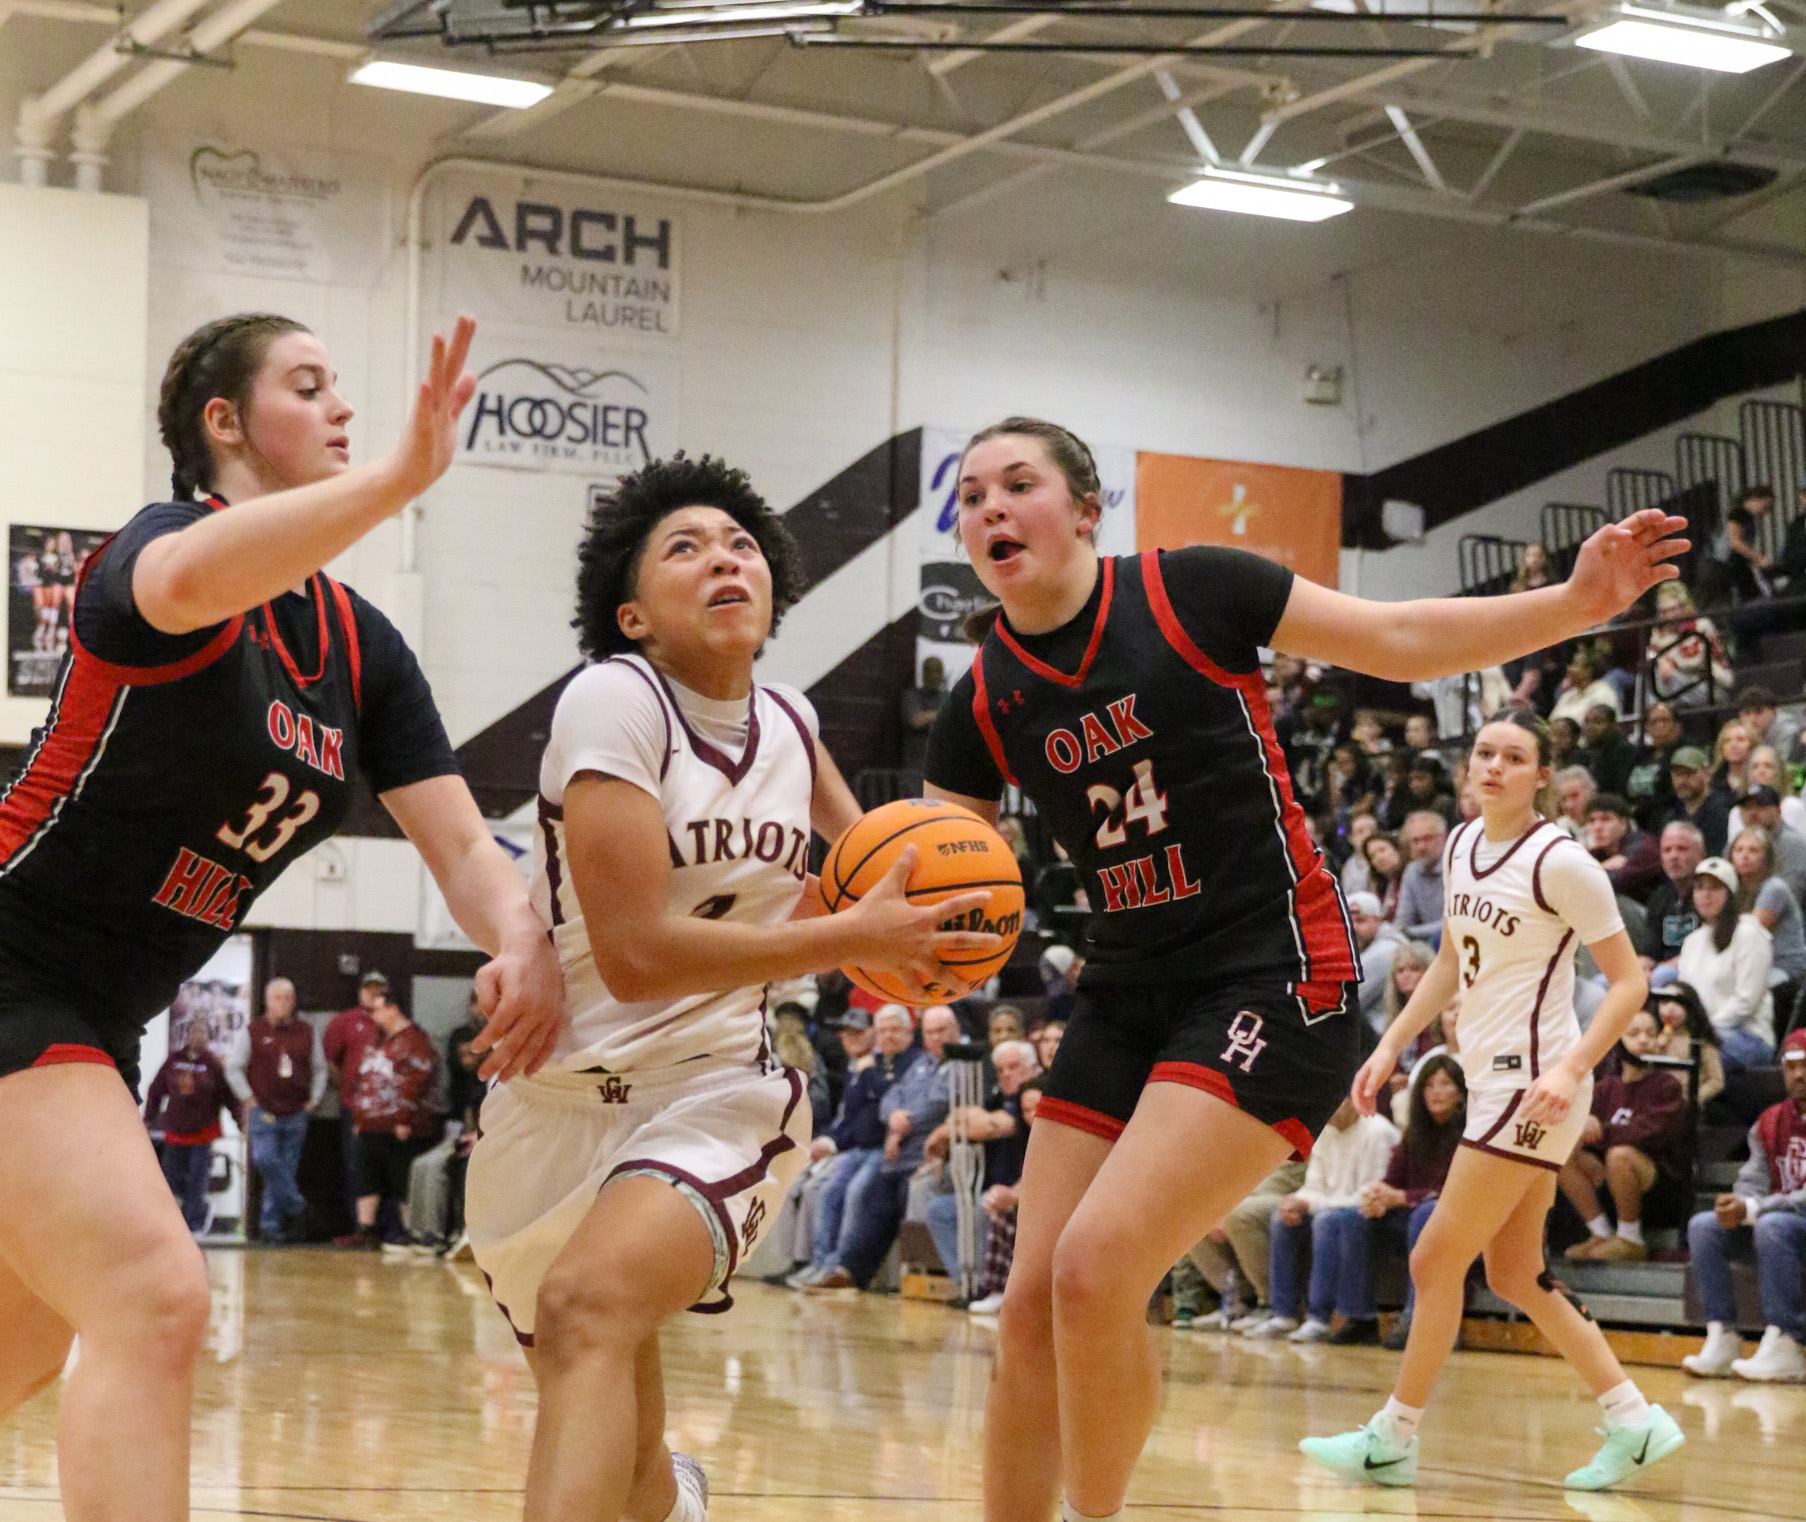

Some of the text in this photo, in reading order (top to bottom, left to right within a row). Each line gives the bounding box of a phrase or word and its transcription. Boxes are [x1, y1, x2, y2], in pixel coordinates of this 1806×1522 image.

[451, 196, 671, 269] ARCH
[521, 264, 671, 304] MOUNTAIN
[565, 299, 668, 333] LAUREL
[467, 393, 650, 461] HOOSIER
[268, 700, 344, 781] OAK
[1045, 693, 1154, 774] OAK
[216, 771, 320, 862] 33
[1086, 758, 1169, 849] 24
[950, 840, 989, 854] NFHS
[1097, 843, 1201, 912] HILL
[1448, 893, 1520, 937] TRIOTS
[1463, 934, 1480, 989] 3
